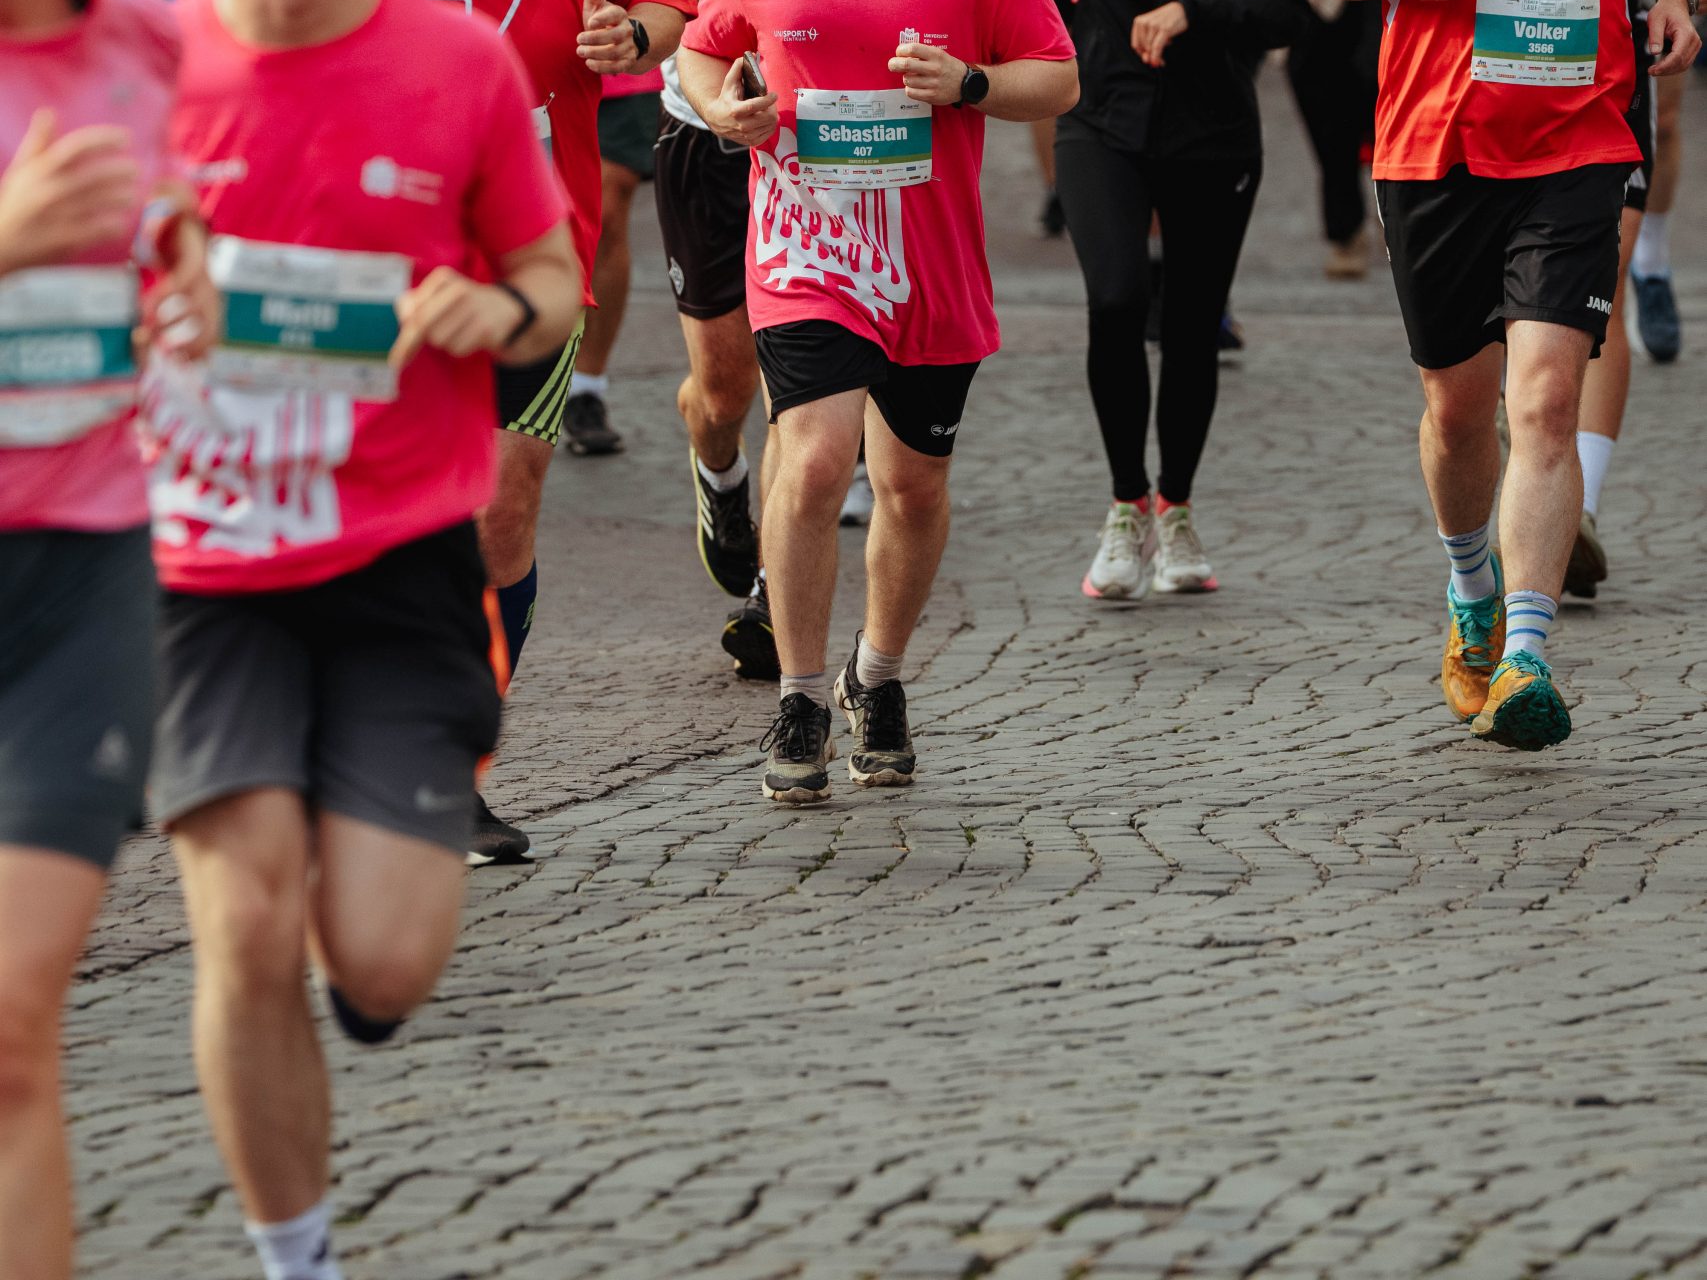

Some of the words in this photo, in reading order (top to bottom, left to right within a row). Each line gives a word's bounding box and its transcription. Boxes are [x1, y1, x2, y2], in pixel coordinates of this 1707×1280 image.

[1514, 20, 1571, 40] Volker
[1528, 42, 1554, 54] 3566
[818, 124, 908, 142] Sebastian
[853, 146, 873, 157] 407
[1586, 295, 1612, 315] JAKO
